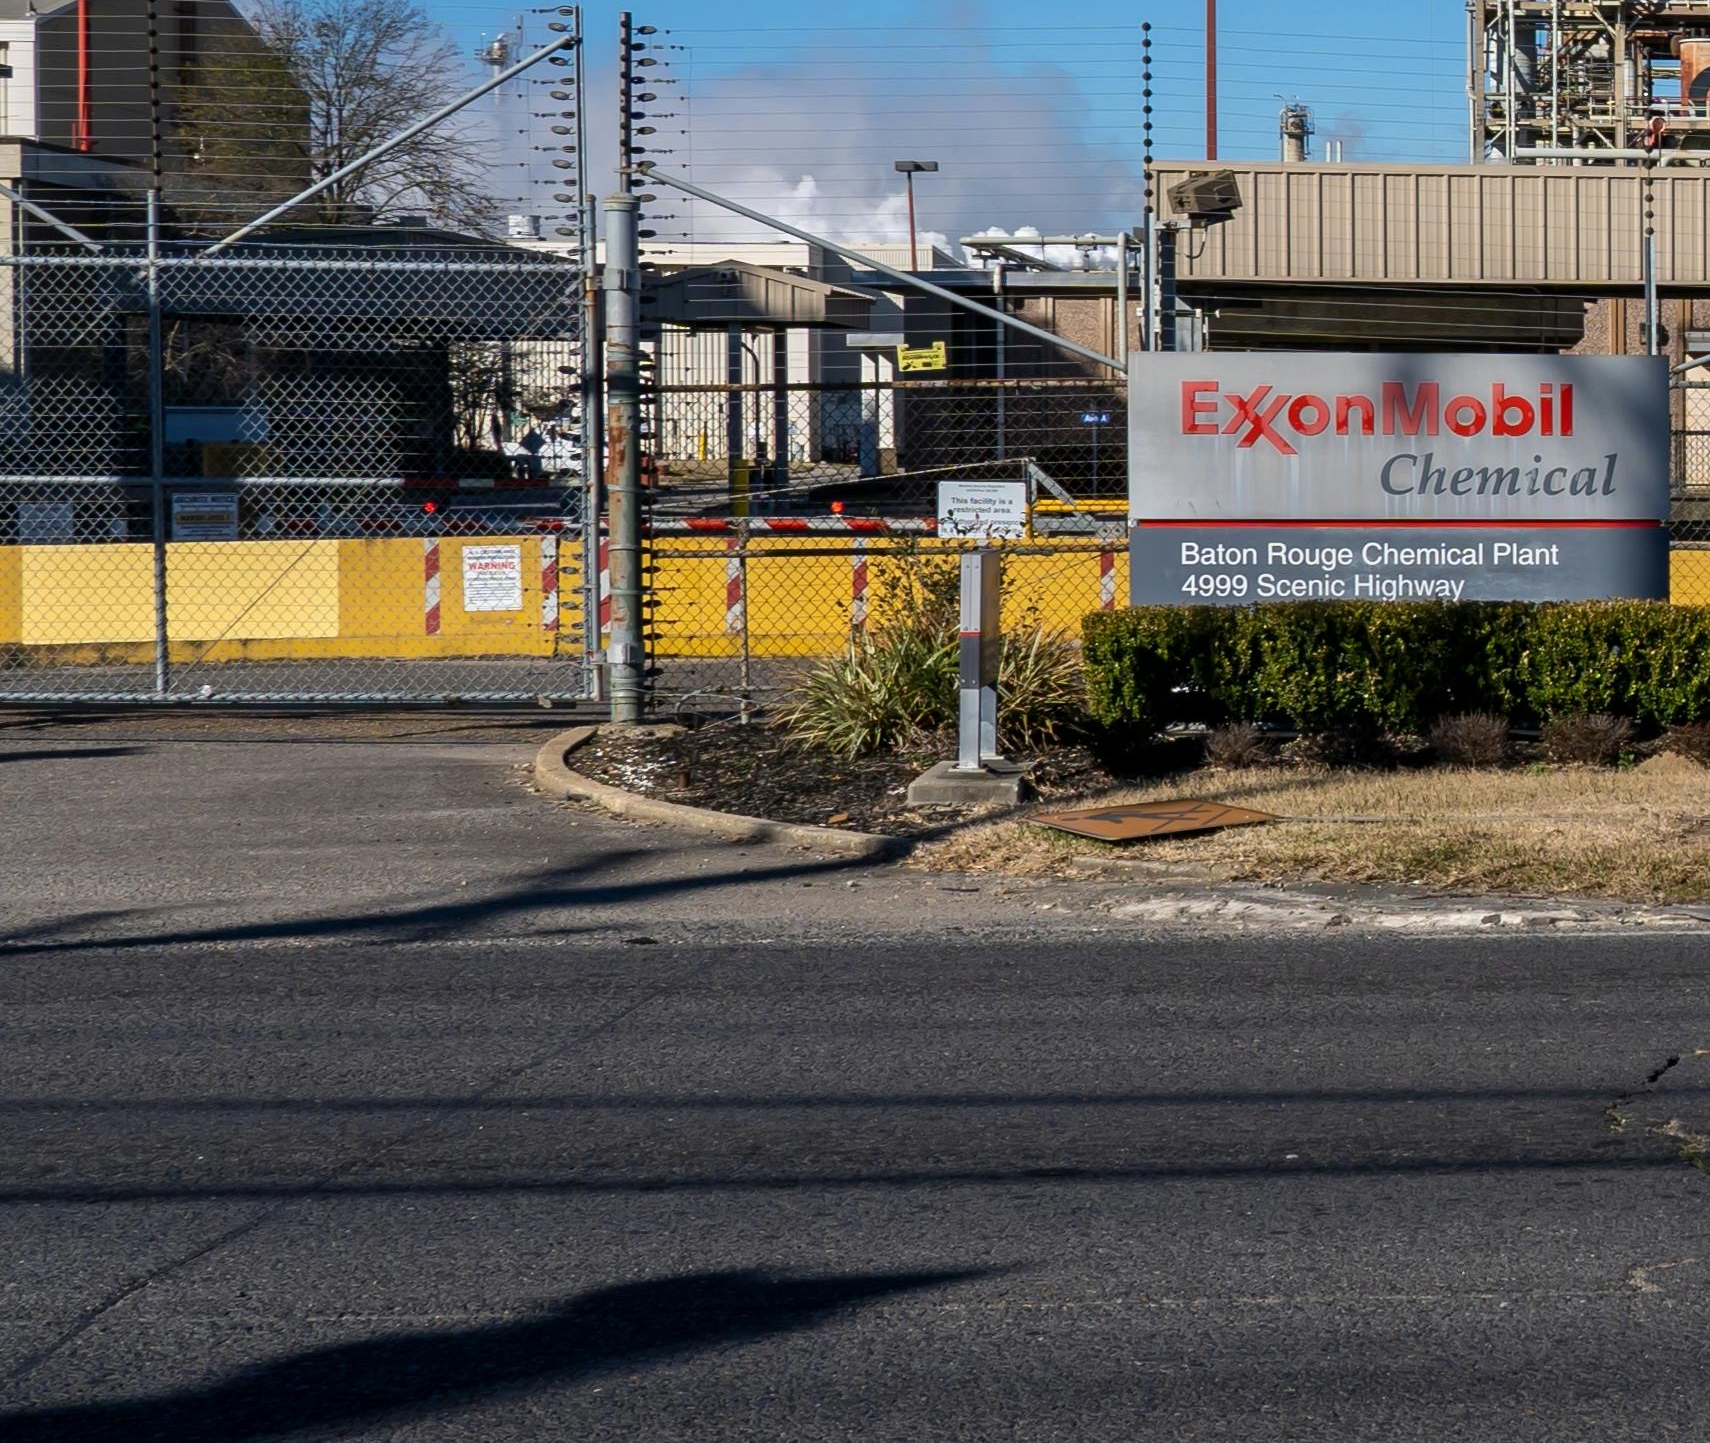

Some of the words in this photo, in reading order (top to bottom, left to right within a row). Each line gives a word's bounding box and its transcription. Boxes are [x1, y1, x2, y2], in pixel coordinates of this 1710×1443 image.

[1181, 380, 1574, 456] ExxonMobil
[1380, 452, 1618, 495] Chemical
[952, 497, 968, 505] This
[970, 497, 997, 506] facility
[998, 497, 1006, 505] is
[469, 561, 515, 571] WARNING
[1181, 542, 1257, 565] Baton
[1268, 542, 1353, 571] Rouge
[1362, 542, 1483, 566] Chemical
[1493, 542, 1559, 566] Plant
[1181, 574, 1248, 597] 4999
[1257, 573, 1345, 597] Scenic
[1354, 574, 1465, 602] Highway
